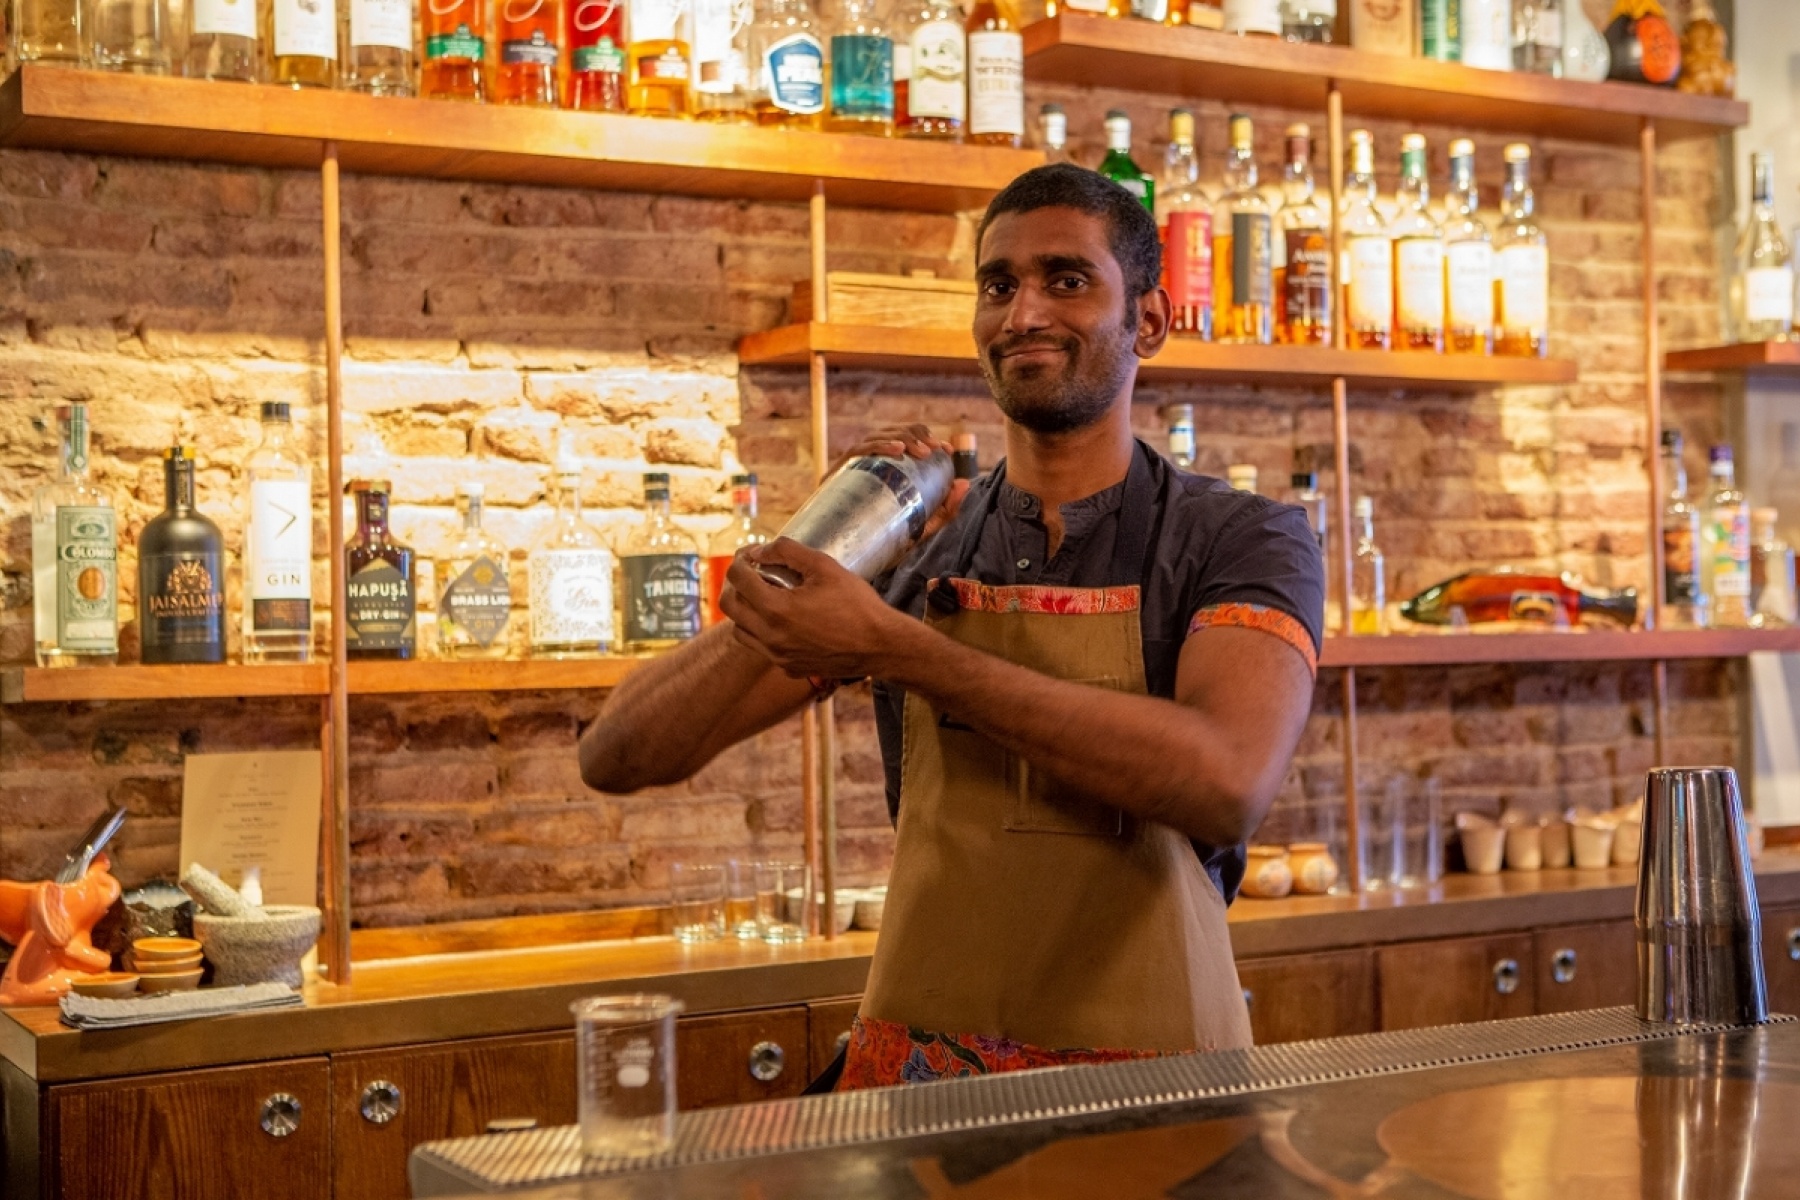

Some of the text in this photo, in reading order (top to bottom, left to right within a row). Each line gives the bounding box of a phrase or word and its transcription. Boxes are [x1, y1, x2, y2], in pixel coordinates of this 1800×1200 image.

[267, 573, 302, 587] GIN
[450, 594, 489, 606] BRASS
[359, 609, 400, 621] DRY GIN
